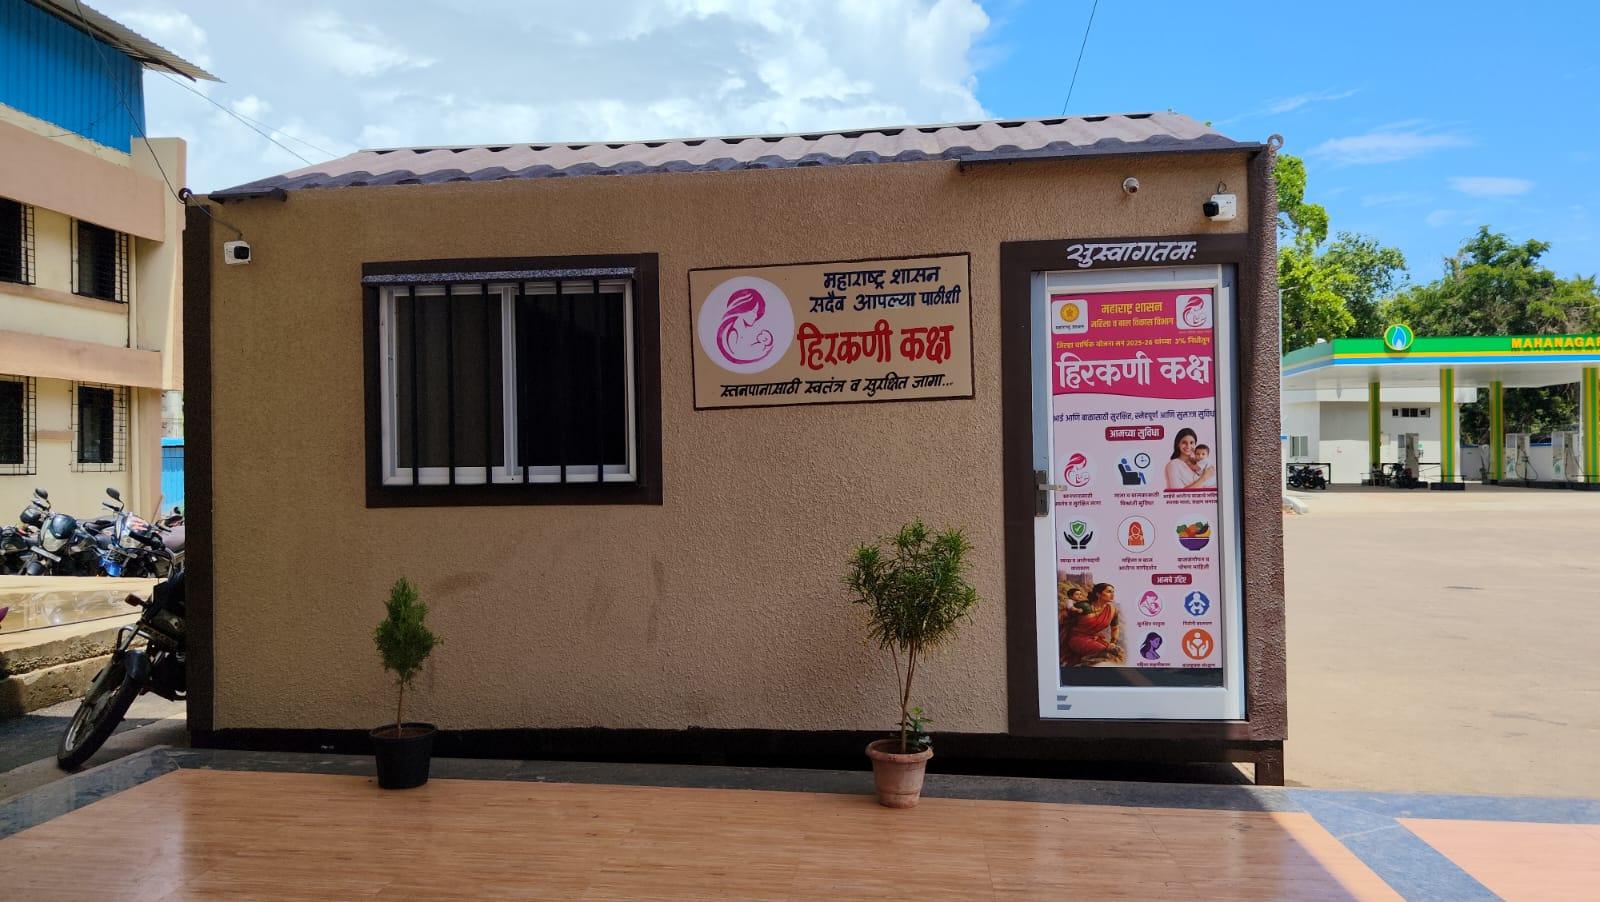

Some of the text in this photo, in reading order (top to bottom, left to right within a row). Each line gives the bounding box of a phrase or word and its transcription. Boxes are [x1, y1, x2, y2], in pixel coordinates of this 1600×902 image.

[823, 266, 942, 290] महाराष्ट्र शासन
[809, 284, 962, 313] सदैव आपल्या पाठीशी
[1135, 301, 1164, 313] शासन
[796, 318, 954, 371] हिरकणी कक्ष
[1055, 350, 1213, 390] हिरकणी कक्ष
[720, 377, 802, 399] स्तनपानासाठी
[804, 376, 847, 395] स्वतंत्र
[850, 378, 859, 392] व
[862, 371, 909, 398] सुरक्षित
[1065, 412, 1081, 422] आणि
[1137, 426, 1160, 440] सुविधा
